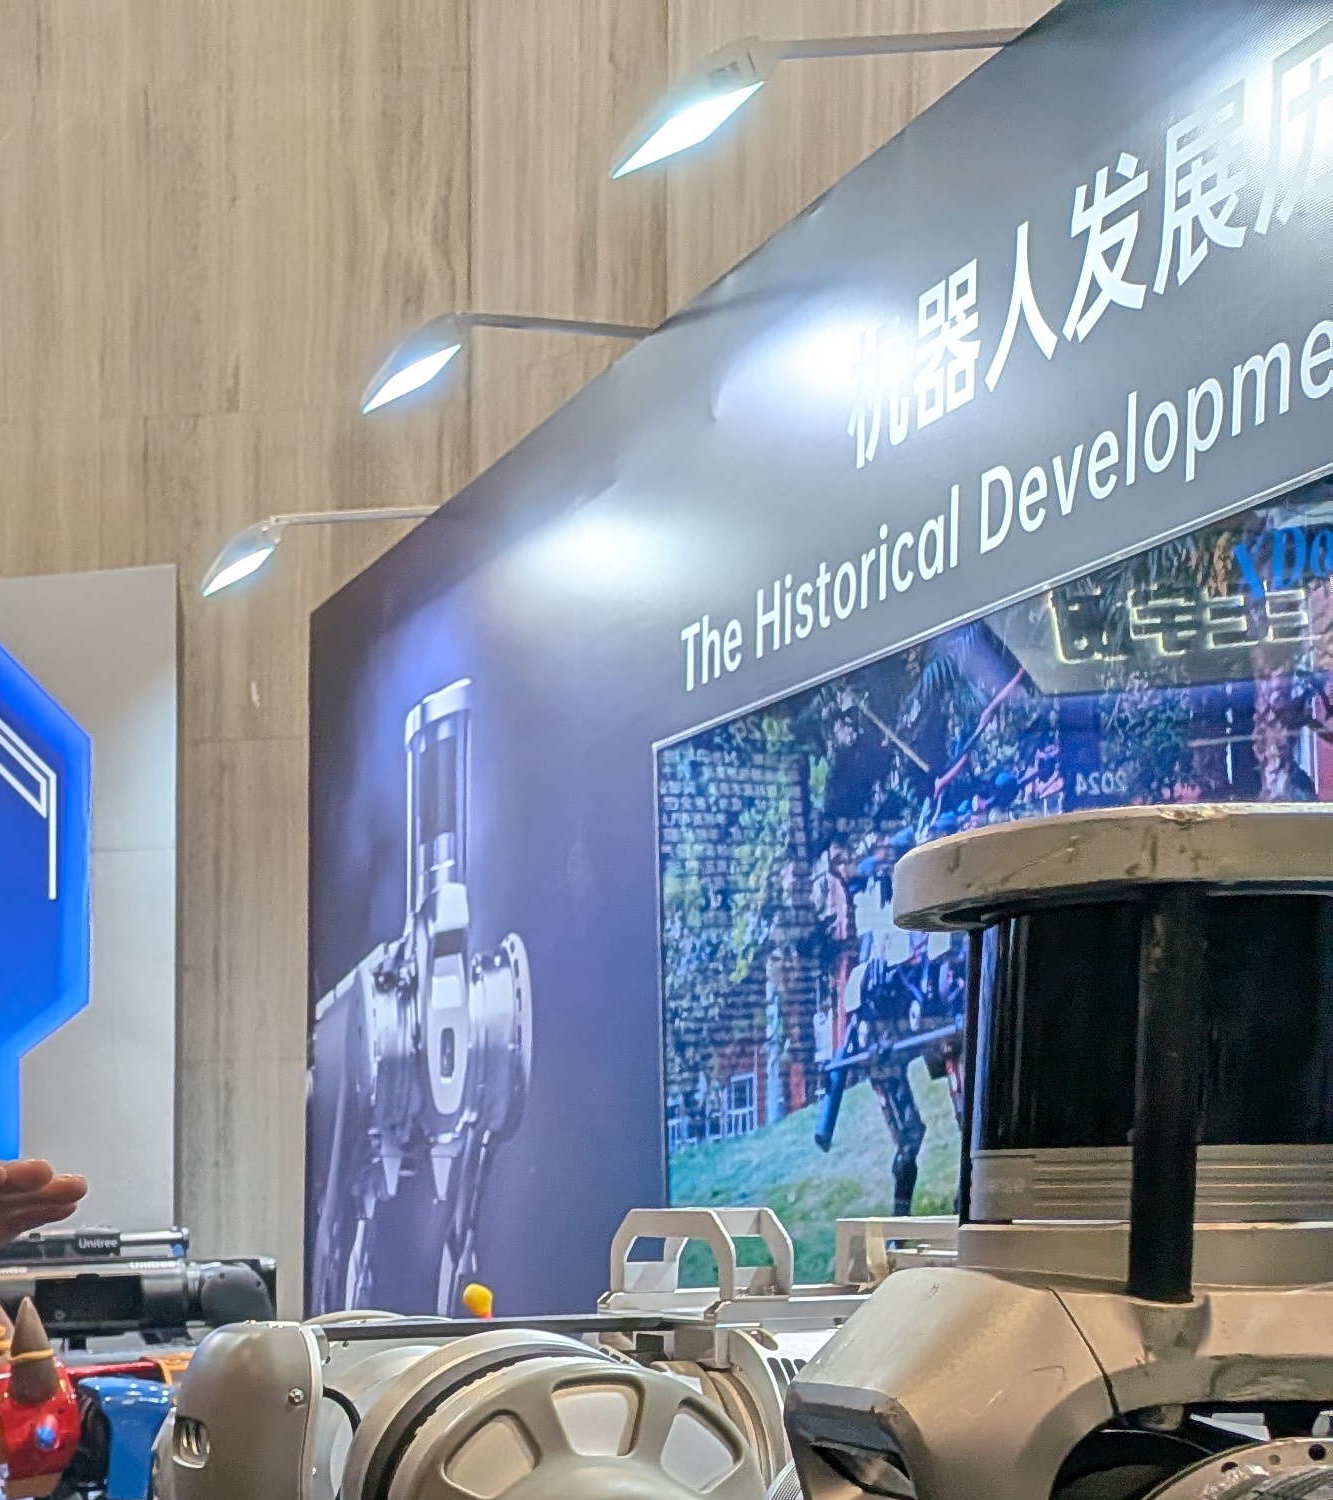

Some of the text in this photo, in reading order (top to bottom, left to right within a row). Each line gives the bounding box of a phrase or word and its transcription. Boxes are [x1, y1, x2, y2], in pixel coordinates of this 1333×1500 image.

[680, 615, 743, 693] The
[756, 486, 960, 661] Historical
[78, 1237, 118, 1250] Unitree
